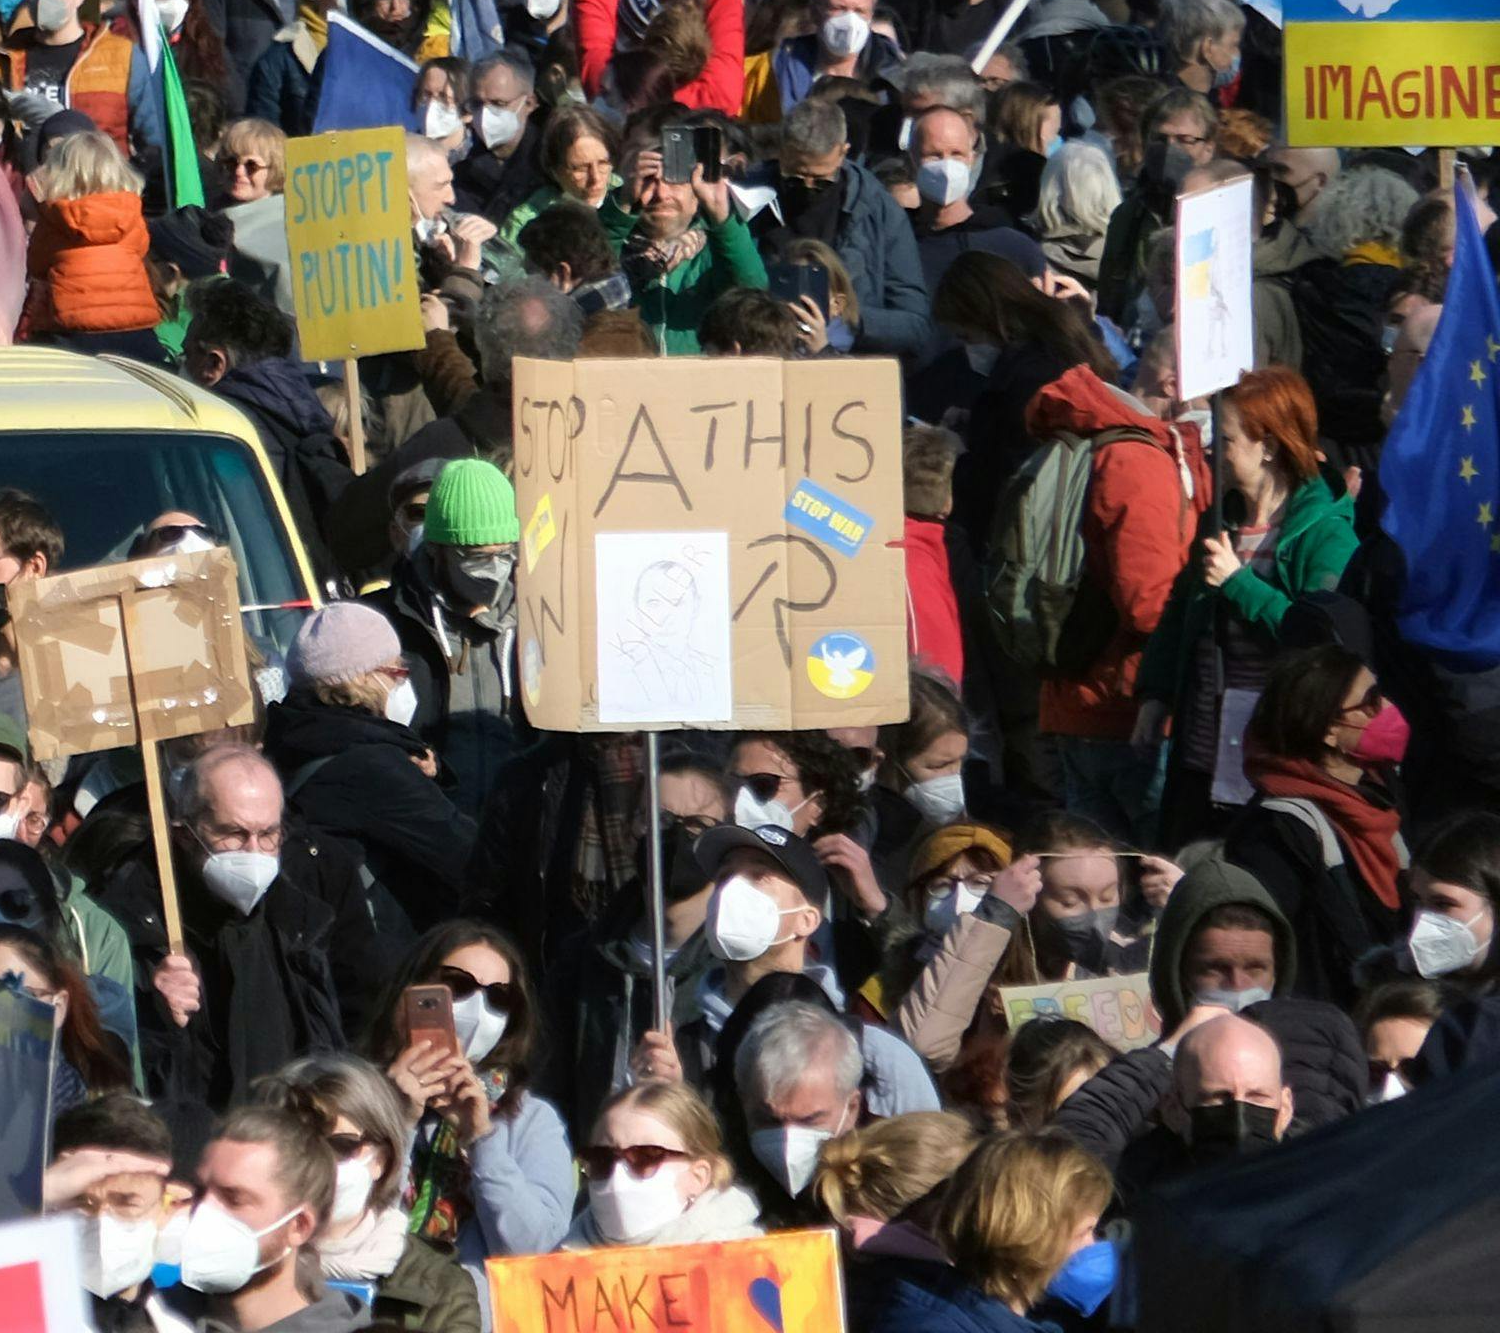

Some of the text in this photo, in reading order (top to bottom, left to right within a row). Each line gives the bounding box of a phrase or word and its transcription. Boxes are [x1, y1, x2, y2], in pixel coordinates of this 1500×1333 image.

[1304, 64, 1500, 122] IMAGINE
[292, 151, 394, 224] STOPPT
[300, 237, 404, 319] PUTIN!
[519, 394, 587, 483] STOP
[689, 399, 875, 484] THIS
[790, 489, 866, 541] STOP WAR
[541, 1273, 694, 1330] MAKE
